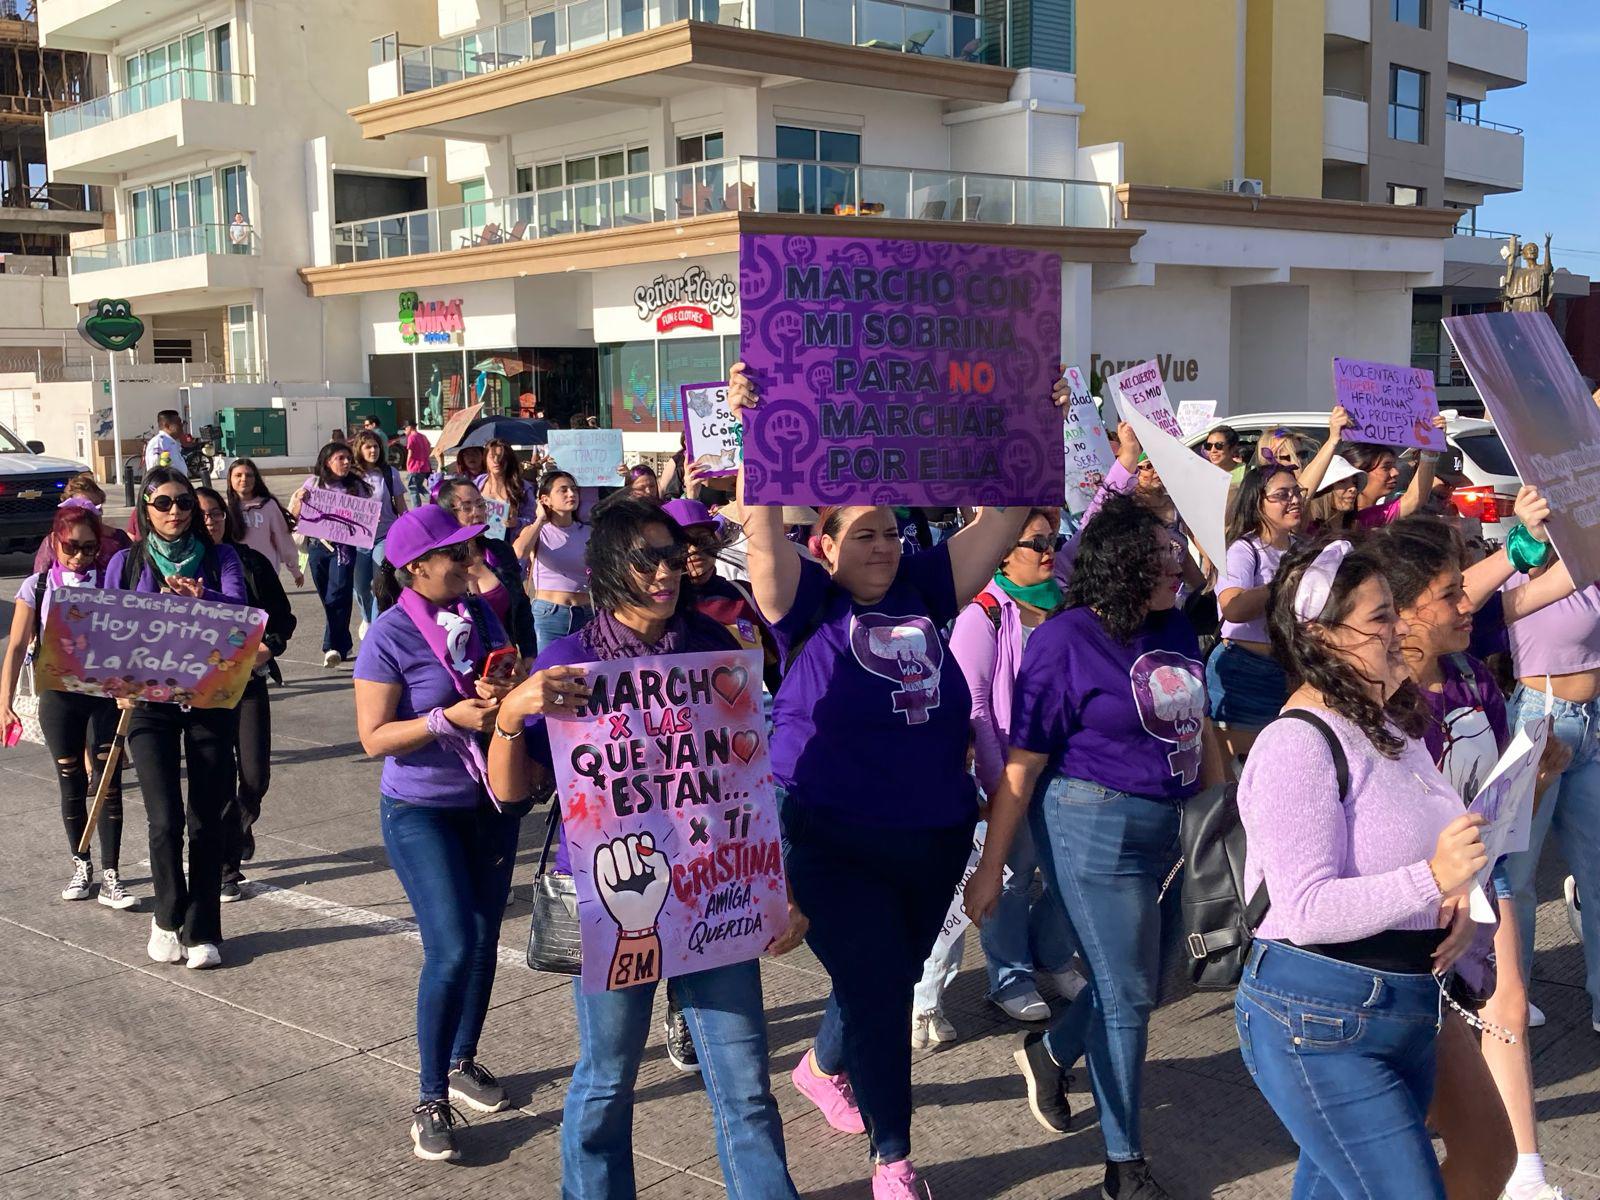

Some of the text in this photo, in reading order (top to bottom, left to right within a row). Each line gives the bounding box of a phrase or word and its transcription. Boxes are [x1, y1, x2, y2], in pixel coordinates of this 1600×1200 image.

[634, 266, 735, 320] Señor Frog's
[785, 264, 1032, 309] MARCHO CON
[678, 309, 703, 324] CLOTHES
[803, 312, 1018, 349] MI SOBRINA
[834, 358, 995, 394] PARA NO
[1132, 369, 1157, 386] CUERPO
[1157, 354, 1199, 382] Vue
[1070, 391, 1092, 406] dad
[1351, 391, 1413, 414] HERMANAS
[820, 403, 1008, 438] MARCHAR
[1364, 423, 1405, 443] QUE?
[827, 447, 1001, 482] POR ELLA
[53, 587, 118, 605] Donde
[91, 611, 221, 645] Hoy grita
[84, 646, 209, 680] La Rabia
[644, 707, 692, 736] LAS
[571, 738, 648, 791] QUE
[612, 769, 750, 817] ESTAN...
[688, 913, 763, 954] QUERIDA
[614, 949, 655, 985] 8M
